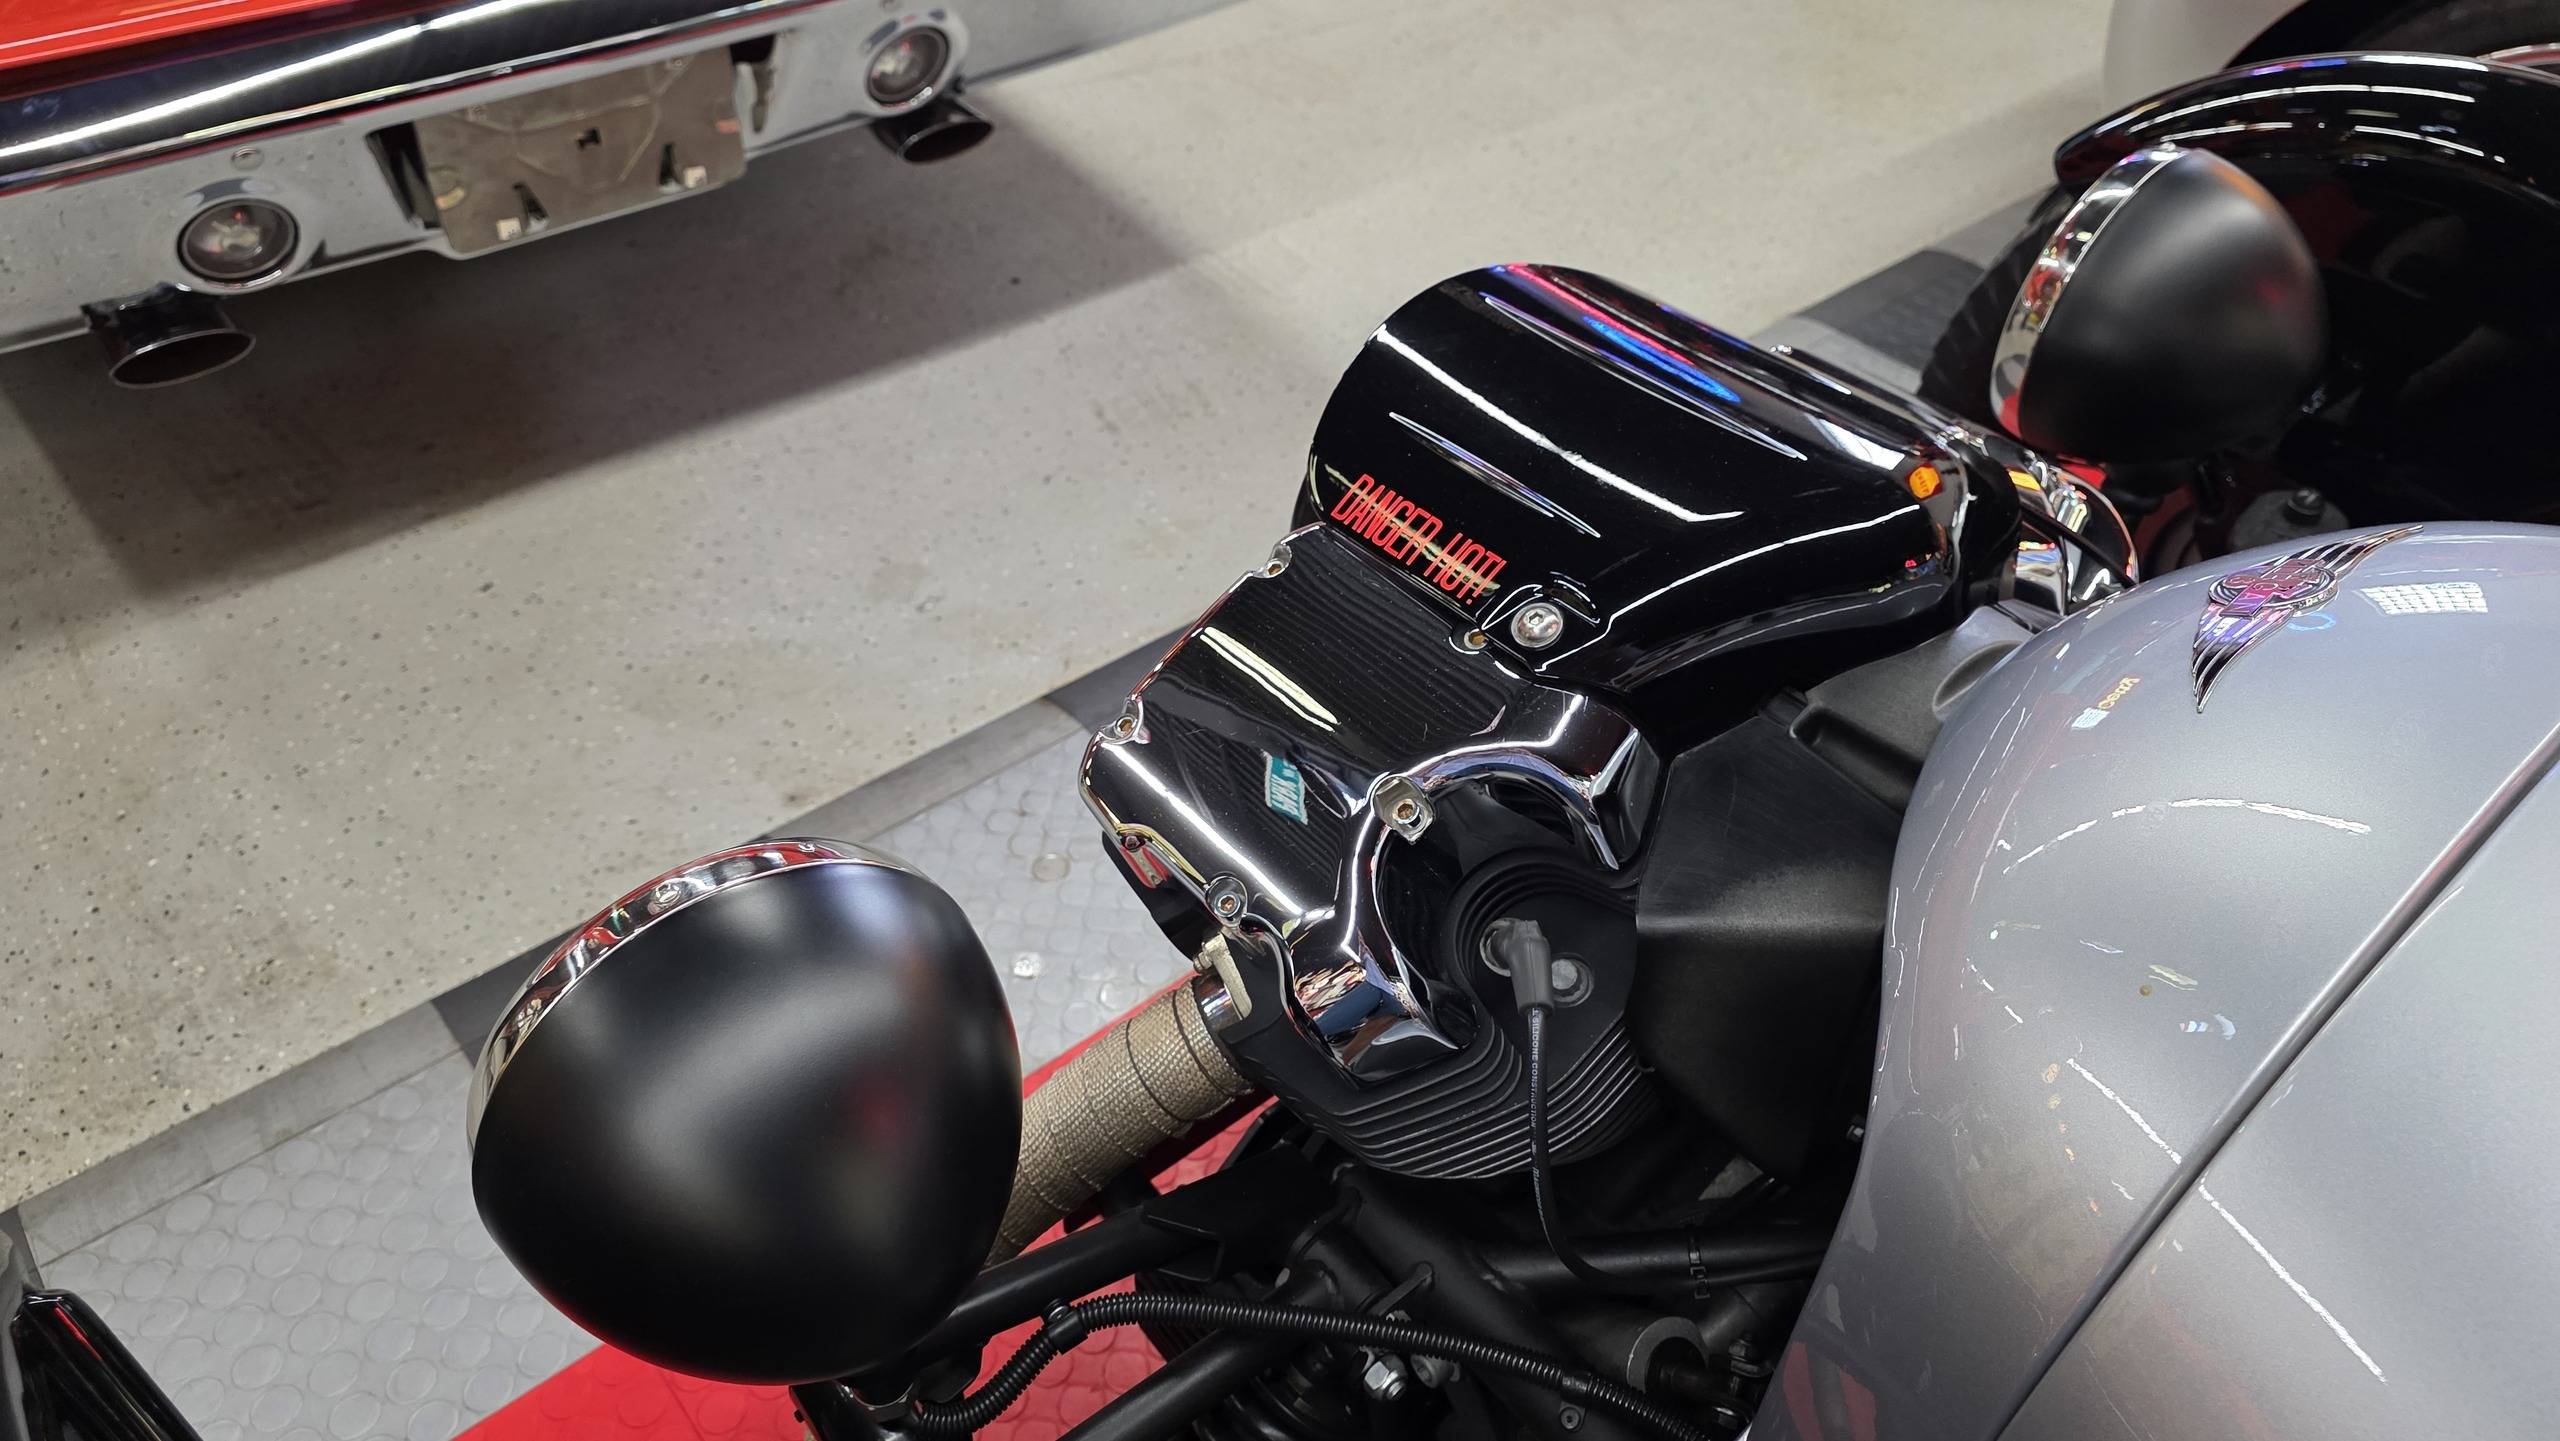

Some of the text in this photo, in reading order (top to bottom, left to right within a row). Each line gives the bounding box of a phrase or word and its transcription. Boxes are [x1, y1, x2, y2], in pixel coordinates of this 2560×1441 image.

[1330, 473, 1507, 605] DANGER HOT!
[1531, 1016, 1540, 1061] SILICONE
[1529, 1062, 1539, 1128] CONSTRUCTION
